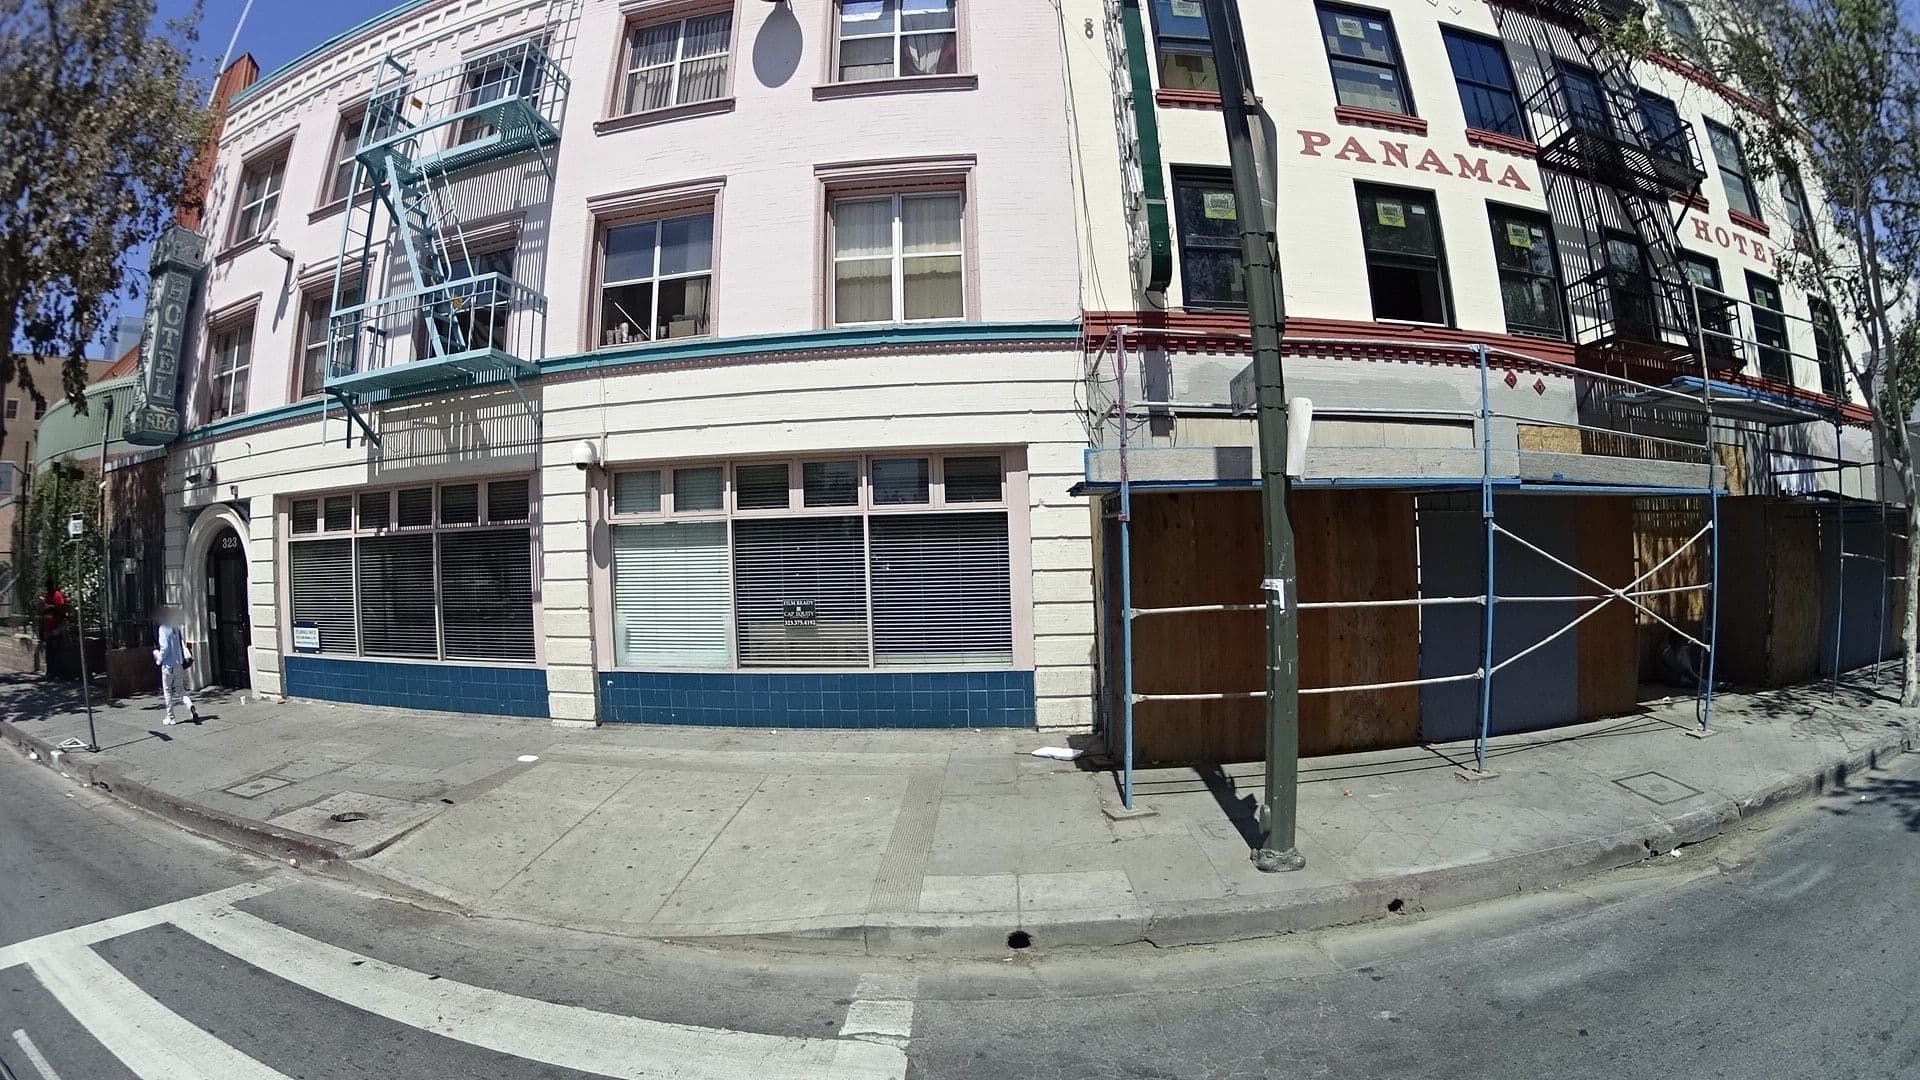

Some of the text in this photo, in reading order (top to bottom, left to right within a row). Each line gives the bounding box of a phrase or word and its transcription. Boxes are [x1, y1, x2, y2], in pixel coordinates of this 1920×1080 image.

[1297, 129, 1531, 192] PANAMA
[153, 277, 187, 400] HOTEL
[145, 412, 178, 431] SRO
[222, 537, 238, 549] 323
